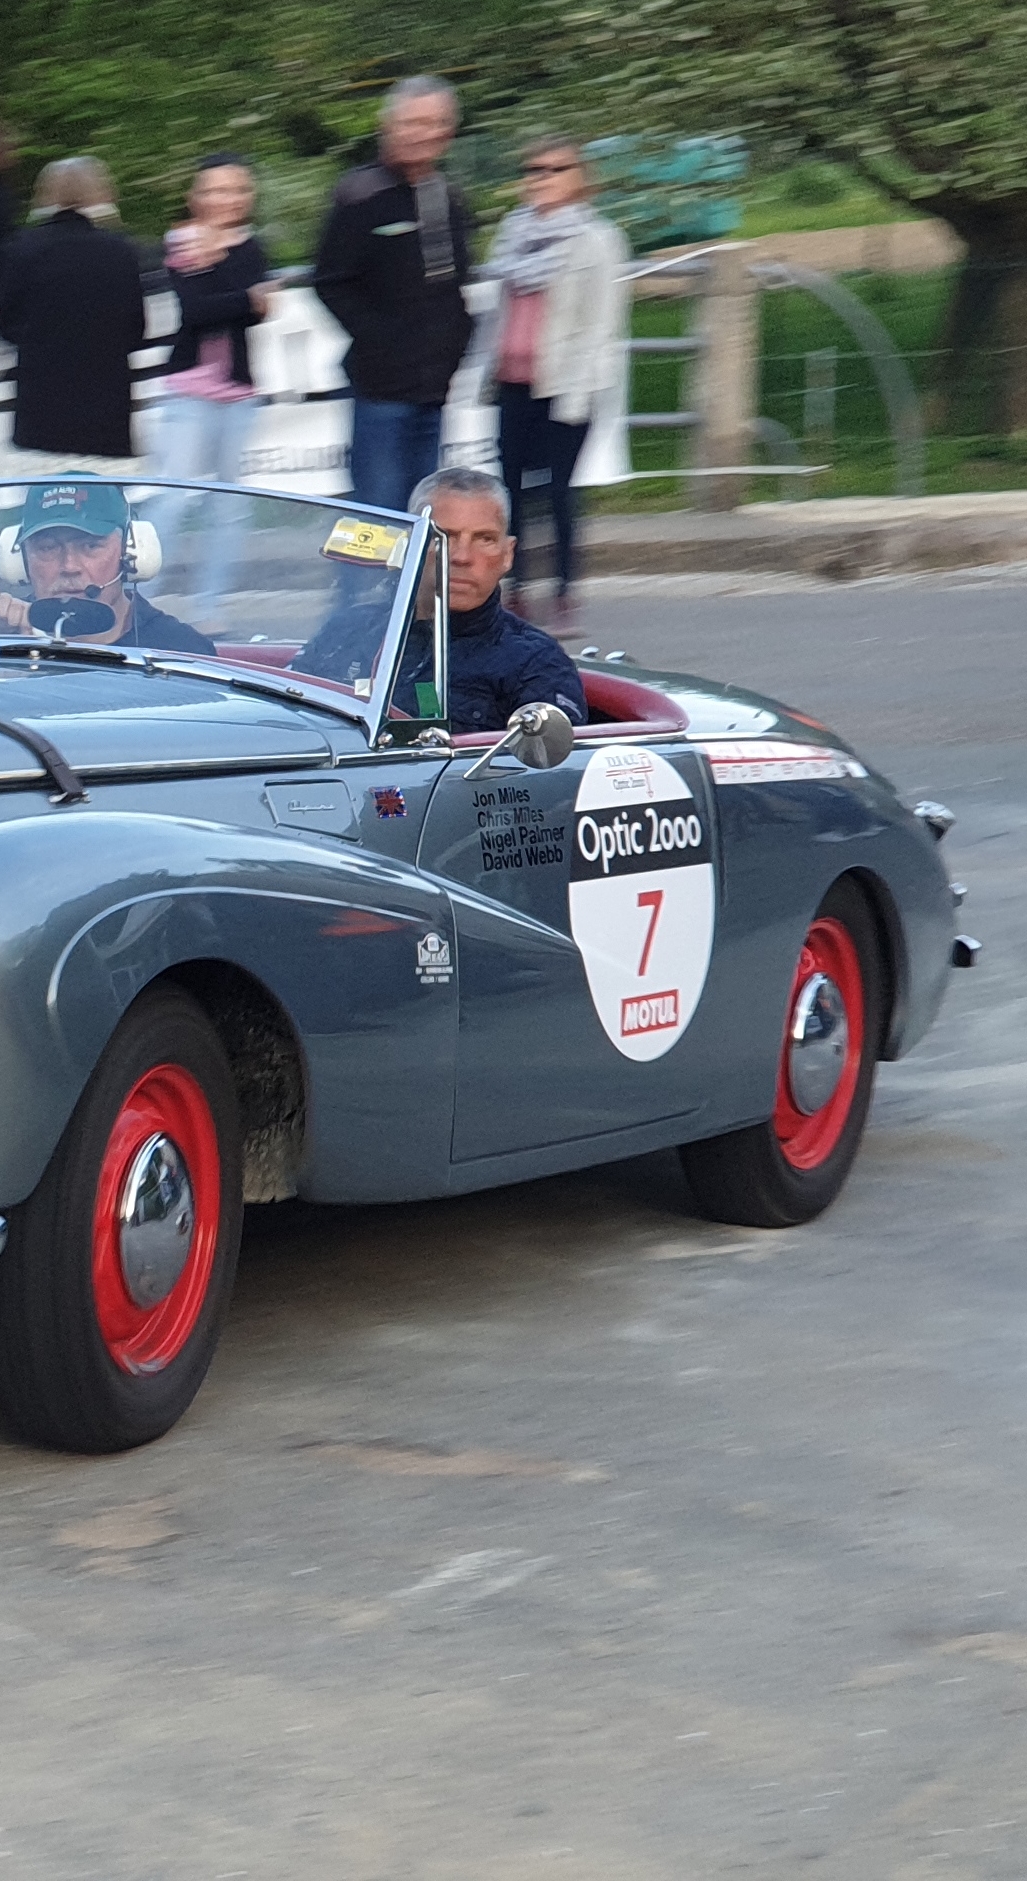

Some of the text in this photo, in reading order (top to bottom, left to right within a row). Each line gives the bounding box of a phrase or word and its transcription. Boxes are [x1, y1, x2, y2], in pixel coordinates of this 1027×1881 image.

[472, 786, 531, 808] Jon Miles
[477, 806, 545, 828] Chris Miles
[479, 825, 565, 854] Nigel Palmer
[577, 807, 702, 874] Optic 2000
[482, 844, 564, 872] David Webb
[636, 889, 665, 977] 7
[622, 994, 678, 1032] MOTUL
